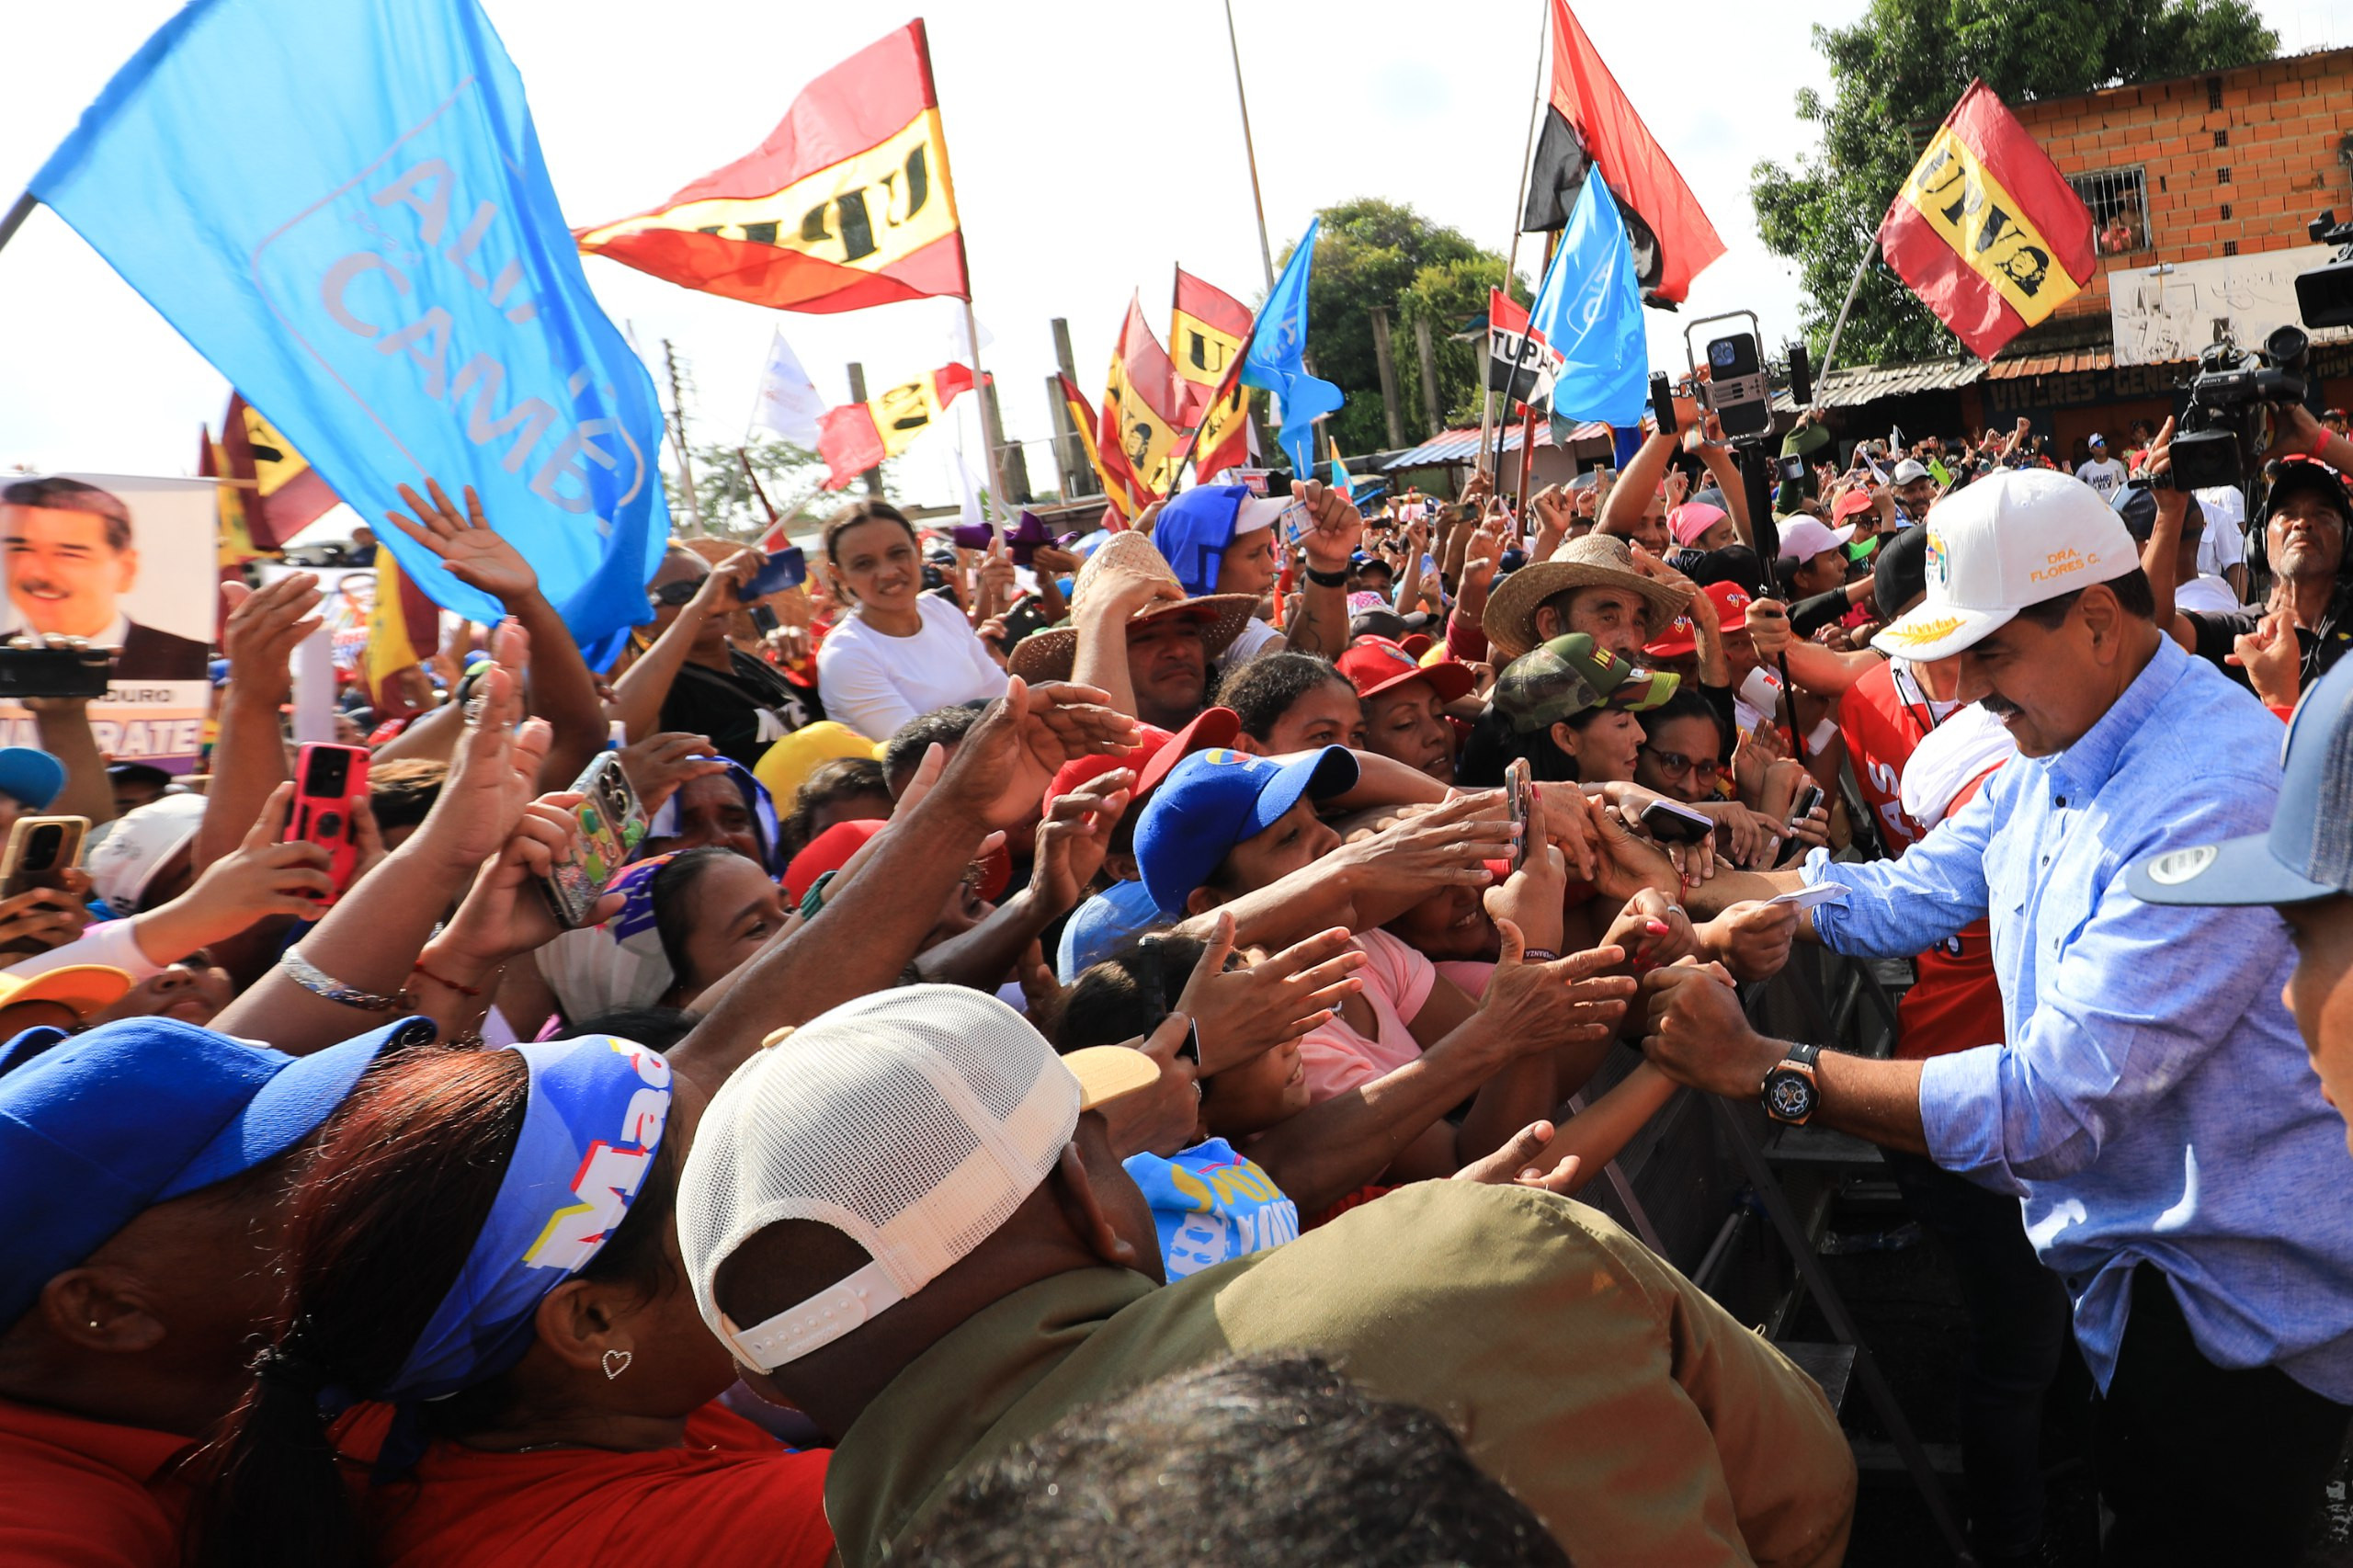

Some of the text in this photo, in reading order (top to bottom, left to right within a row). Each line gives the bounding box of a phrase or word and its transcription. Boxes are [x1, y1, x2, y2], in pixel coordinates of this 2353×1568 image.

[1916, 147, 2028, 255] UPV
[1990, 369, 2097, 413] VIVERES
[2029, 552, 2101, 583] FLORES C.
[2047, 547, 2081, 564] DRA.
[103, 689, 173, 702] DURO
